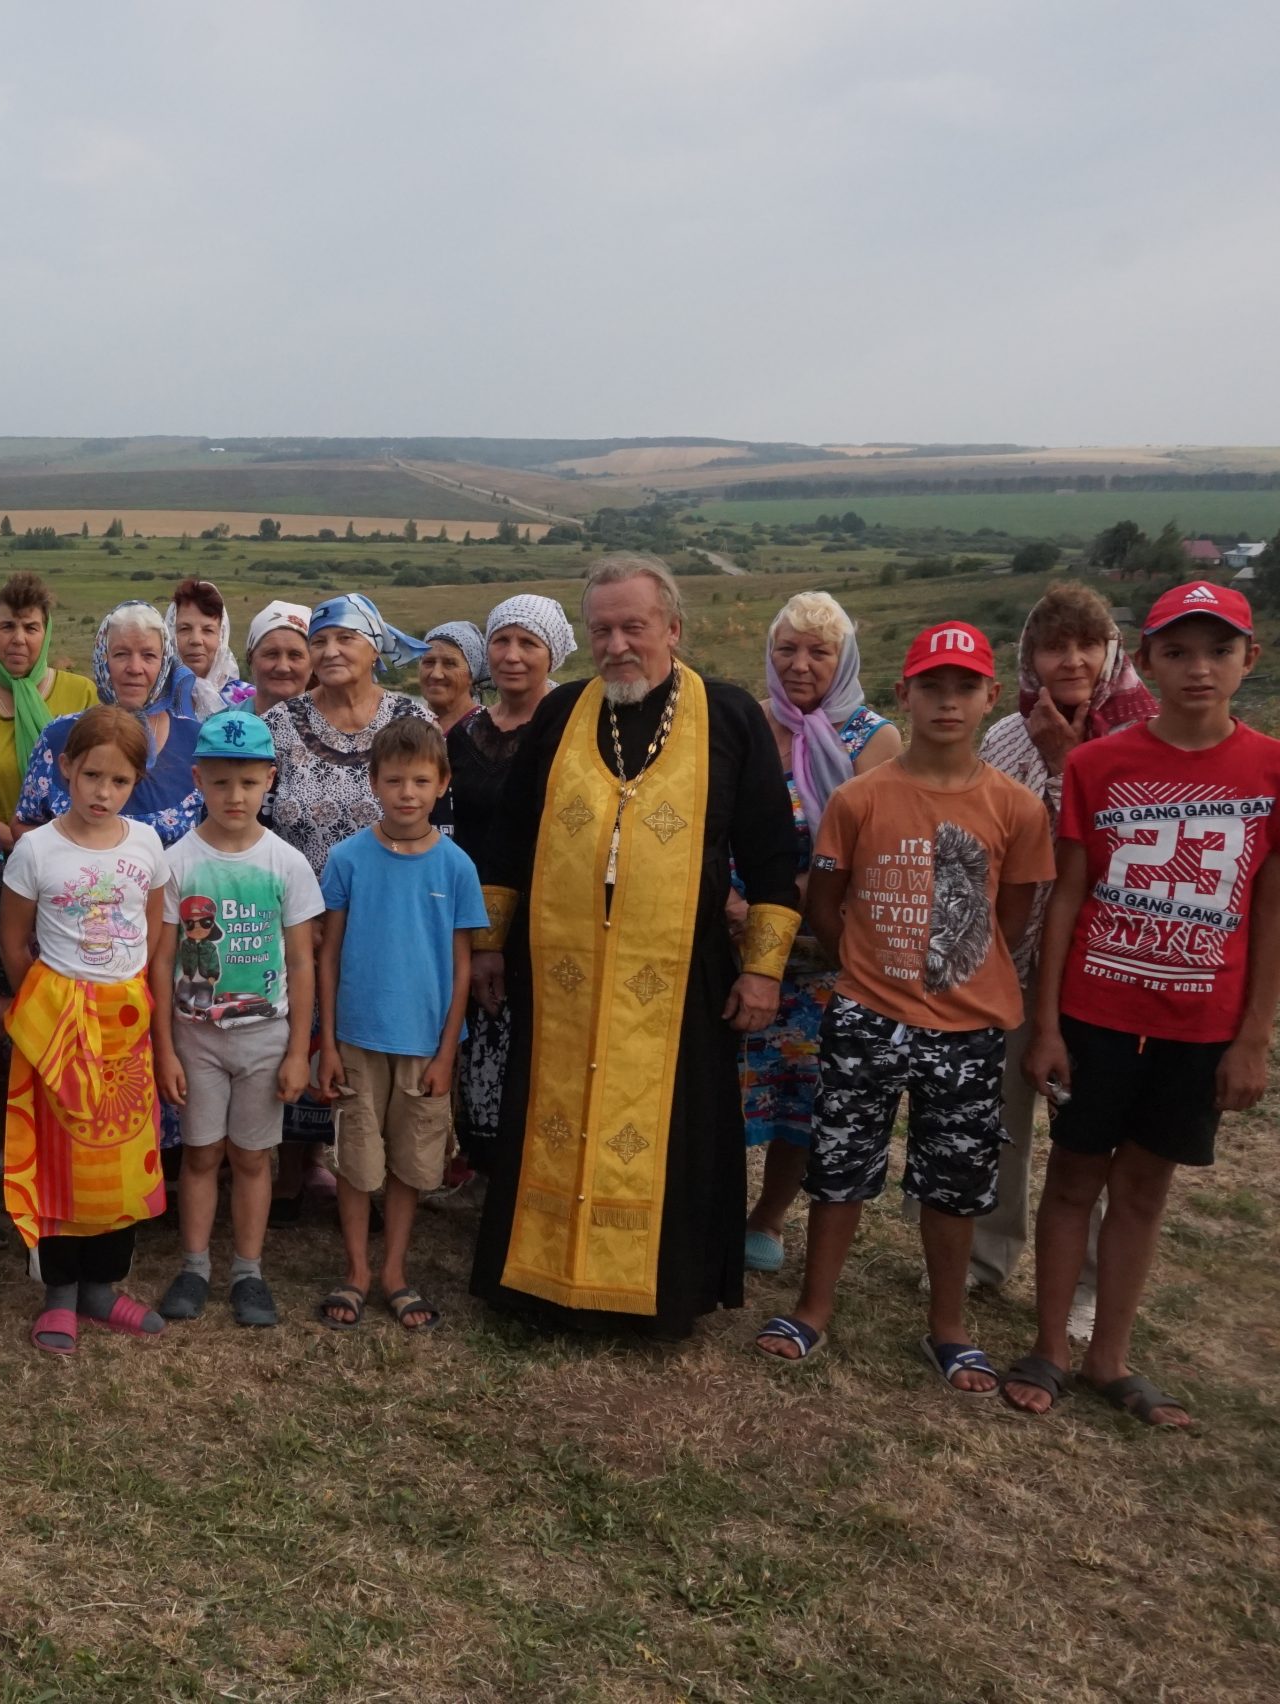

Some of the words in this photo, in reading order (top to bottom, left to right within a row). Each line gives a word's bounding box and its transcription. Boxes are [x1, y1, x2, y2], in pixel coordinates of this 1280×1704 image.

[1183, 597, 1218, 605] adidas
[1130, 806, 1180, 821] GANG
[1185, 803, 1234, 817] GANG
[900, 838, 932, 854] IT'S
[878, 855, 891, 866] UP
[895, 855, 907, 866] TO
[912, 856, 932, 867] YOU
[1107, 817, 1246, 911] 23
[865, 868, 932, 891] HOW
[873, 891, 909, 905] YOU'LL
[911, 895, 928, 905] GO.
[871, 905, 885, 920] IF
[890, 907, 928, 925] YOU
[1125, 894, 1173, 914] GANG
[1177, 905, 1223, 926] GANG
[875, 924, 902, 935] DON'T
[905, 927, 926, 938] TRY.
[1107, 912, 1216, 957] NYC
[230, 935, 262, 951] КТО
[888, 937, 924, 951] YOU'LL
[226, 951, 270, 964] ГЛАВНЫЙ
[884, 965, 921, 980] KNOW.
[1083, 964, 1138, 984] EXPLORE
[1144, 979, 1169, 992] THE
[1174, 983, 1213, 993] WORLD
